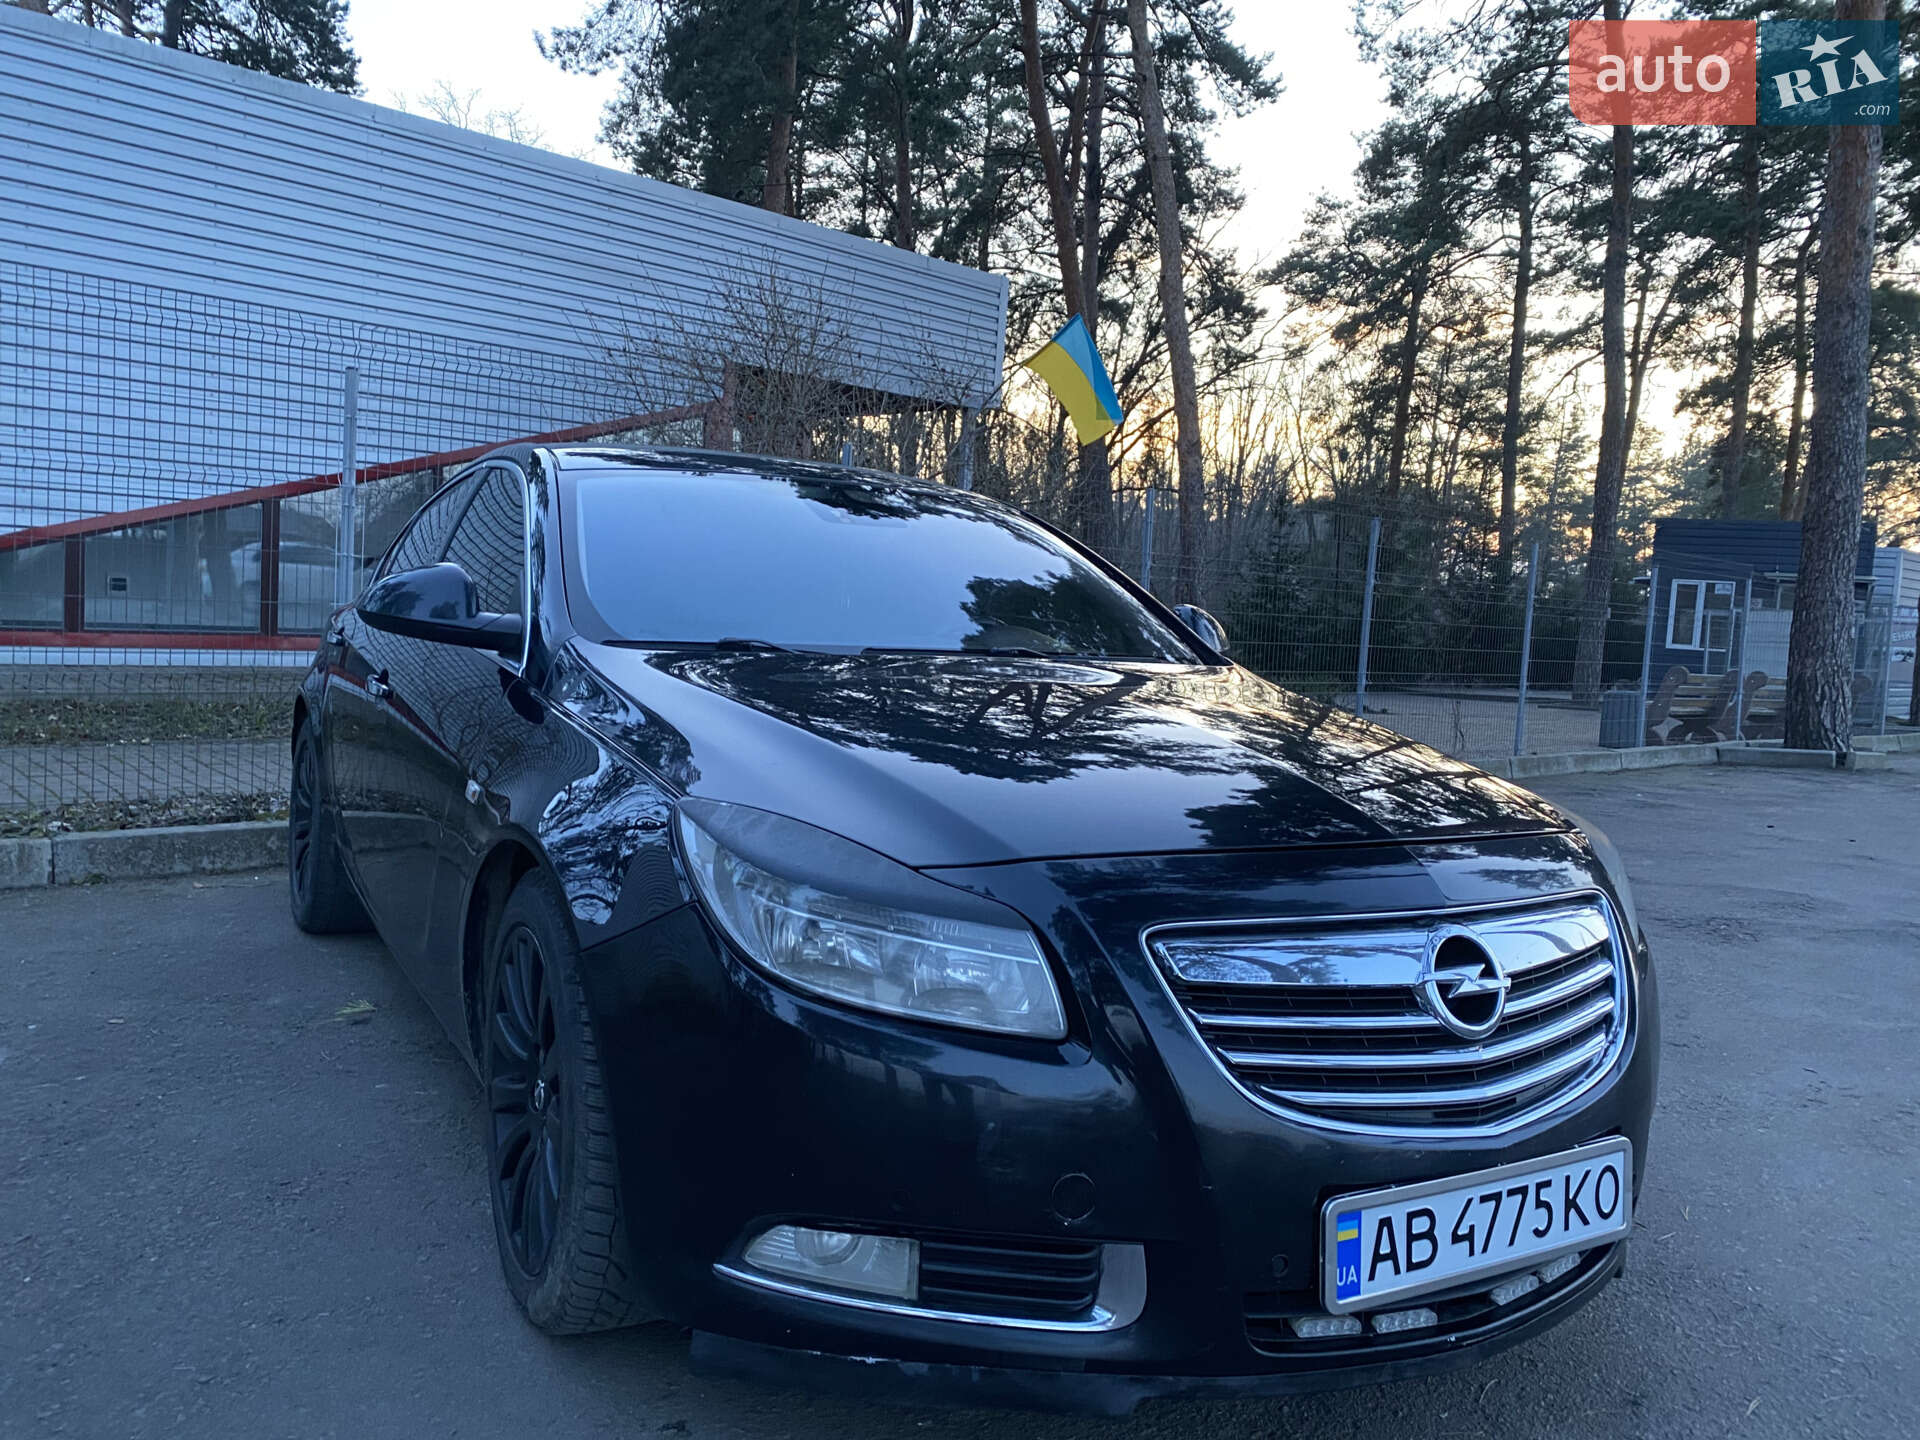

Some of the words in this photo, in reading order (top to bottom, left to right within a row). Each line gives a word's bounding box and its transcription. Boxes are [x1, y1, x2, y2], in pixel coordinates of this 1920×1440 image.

[1368, 1207, 1439, 1282] AB
[1451, 1179, 1553, 1257] 4775
[1336, 1264, 1358, 1286] UA
